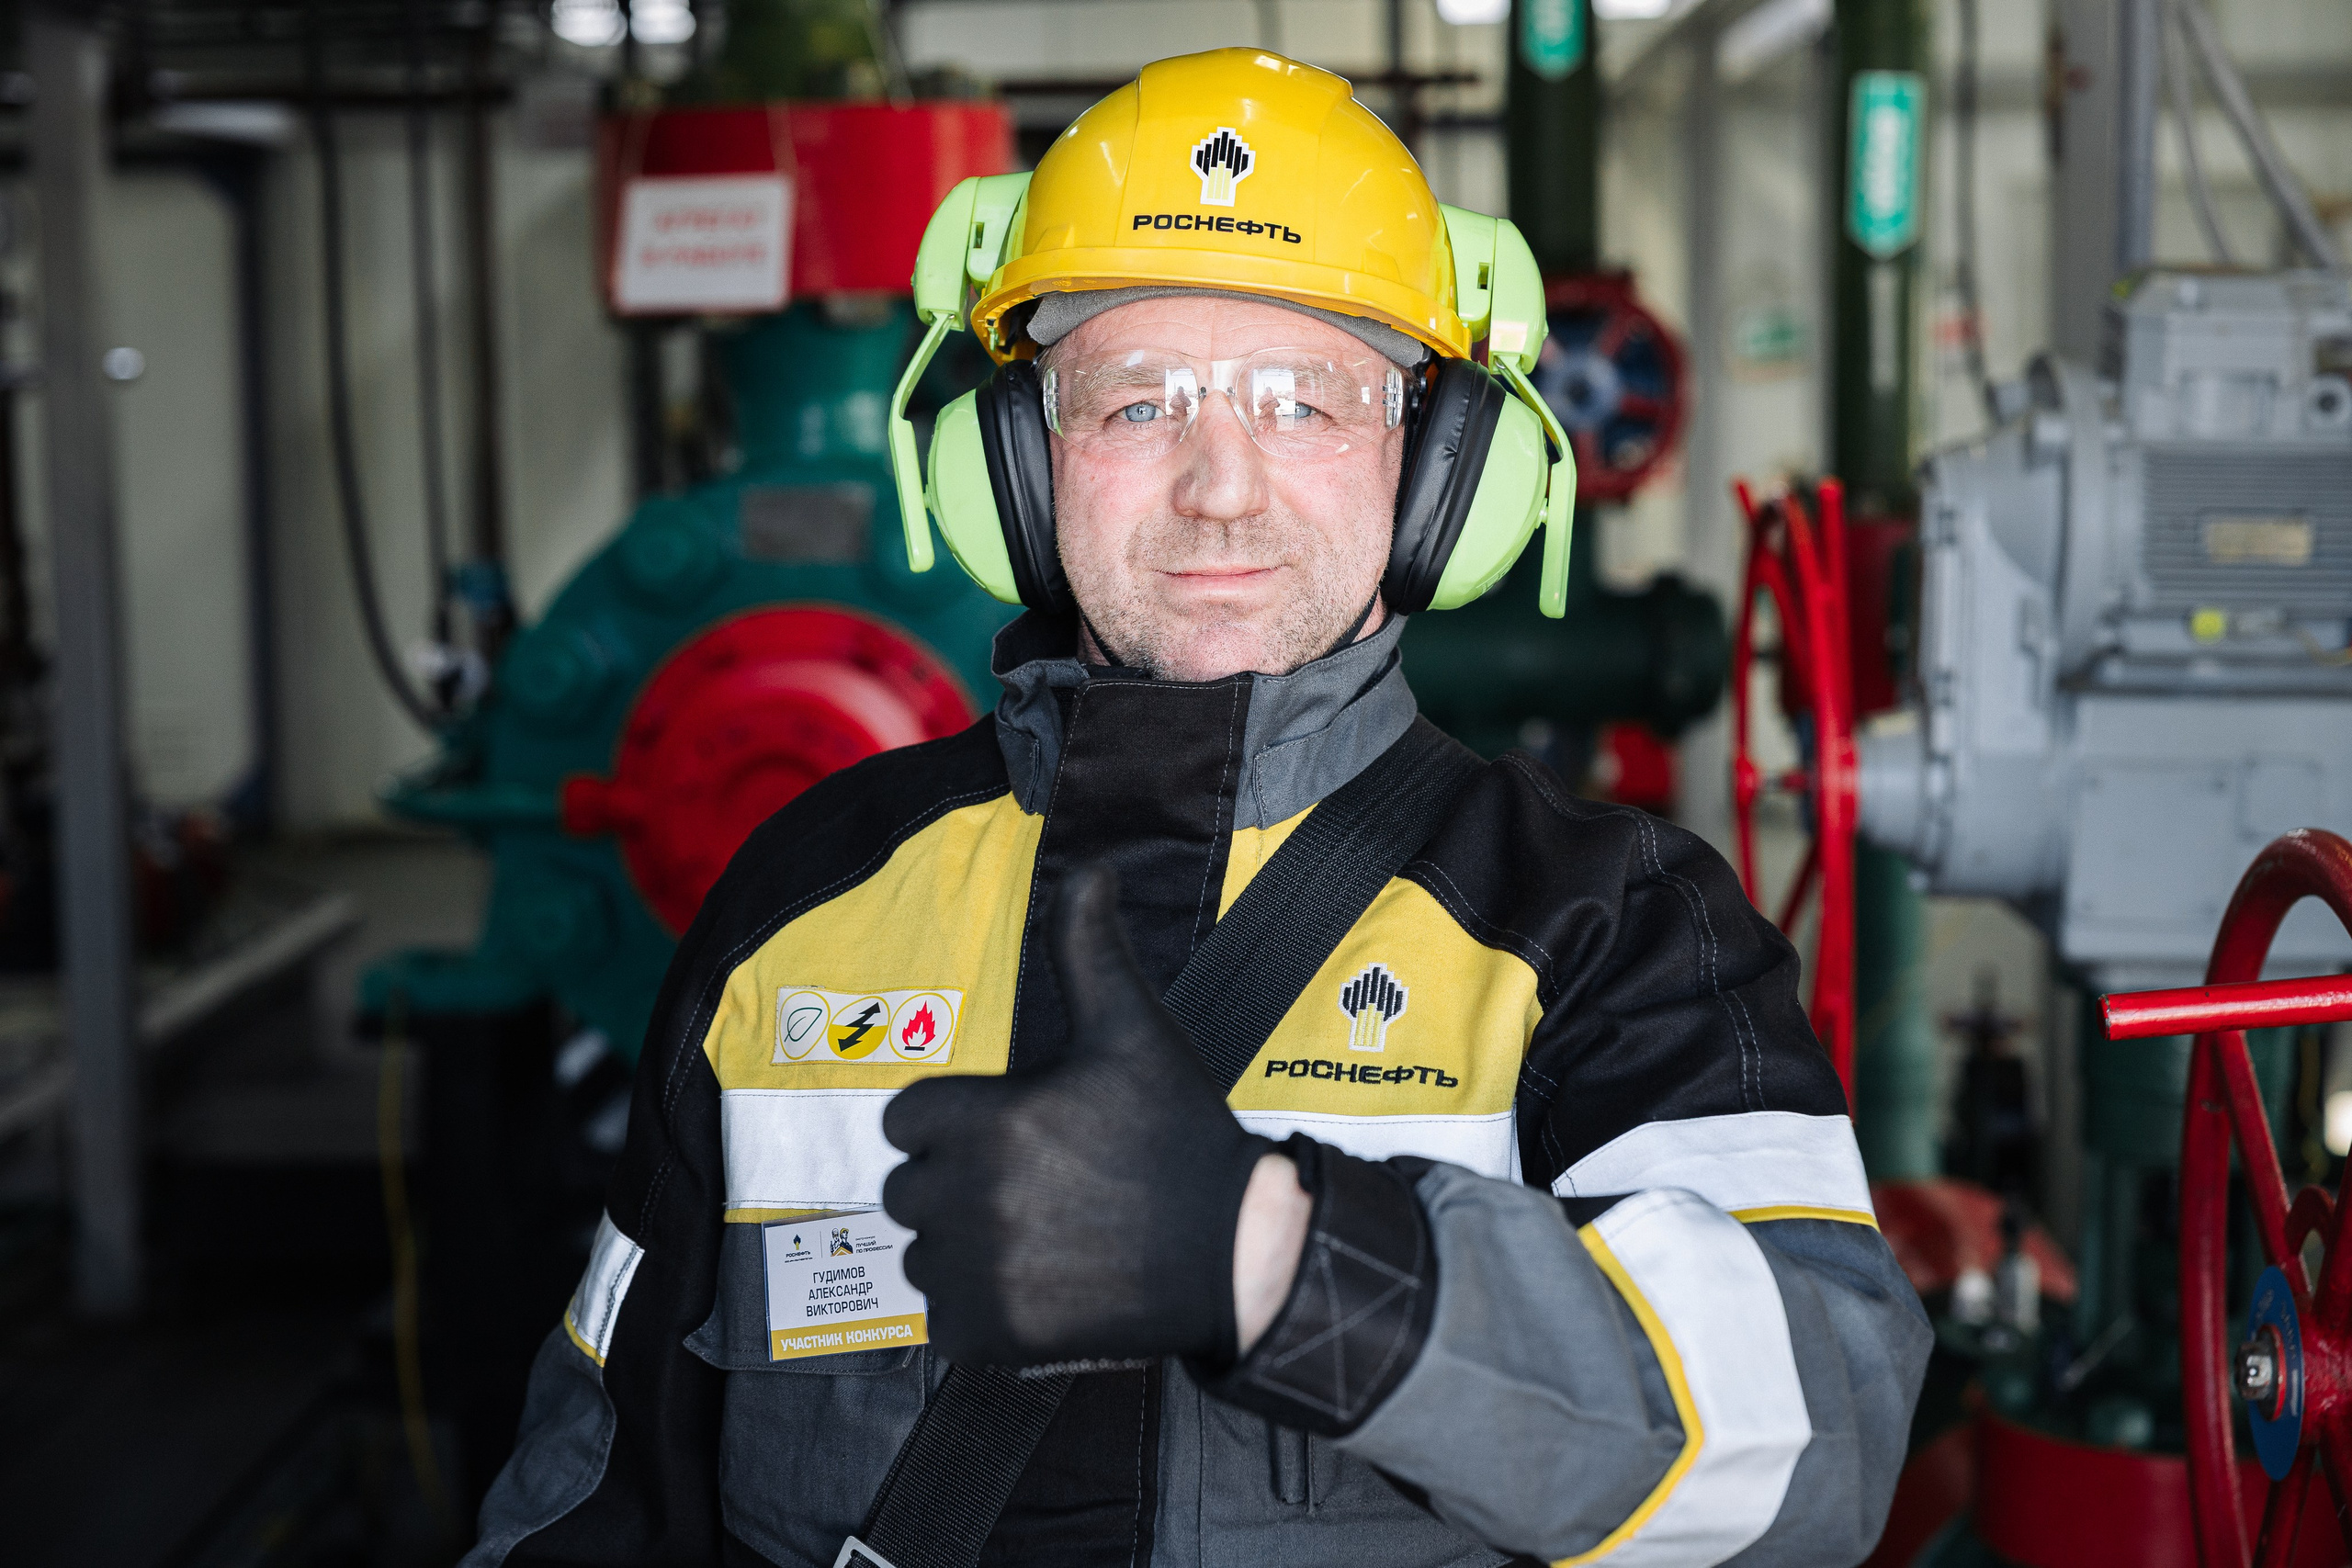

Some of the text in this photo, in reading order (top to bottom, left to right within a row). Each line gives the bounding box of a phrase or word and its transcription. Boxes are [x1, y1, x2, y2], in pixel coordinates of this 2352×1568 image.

[1133, 214, 1302, 244] РОСНЕФТЬ
[1264, 1058, 1459, 1089] РОСНЕФТЬ
[812, 1266, 865, 1284] ГУДИМОВ
[808, 1281, 874, 1301] АЛЕКСАНДР
[806, 1297, 879, 1317] ВИКТОРОВИЧ
[780, 1324, 913, 1352] УЧАСТНИК КОНКУРСА
